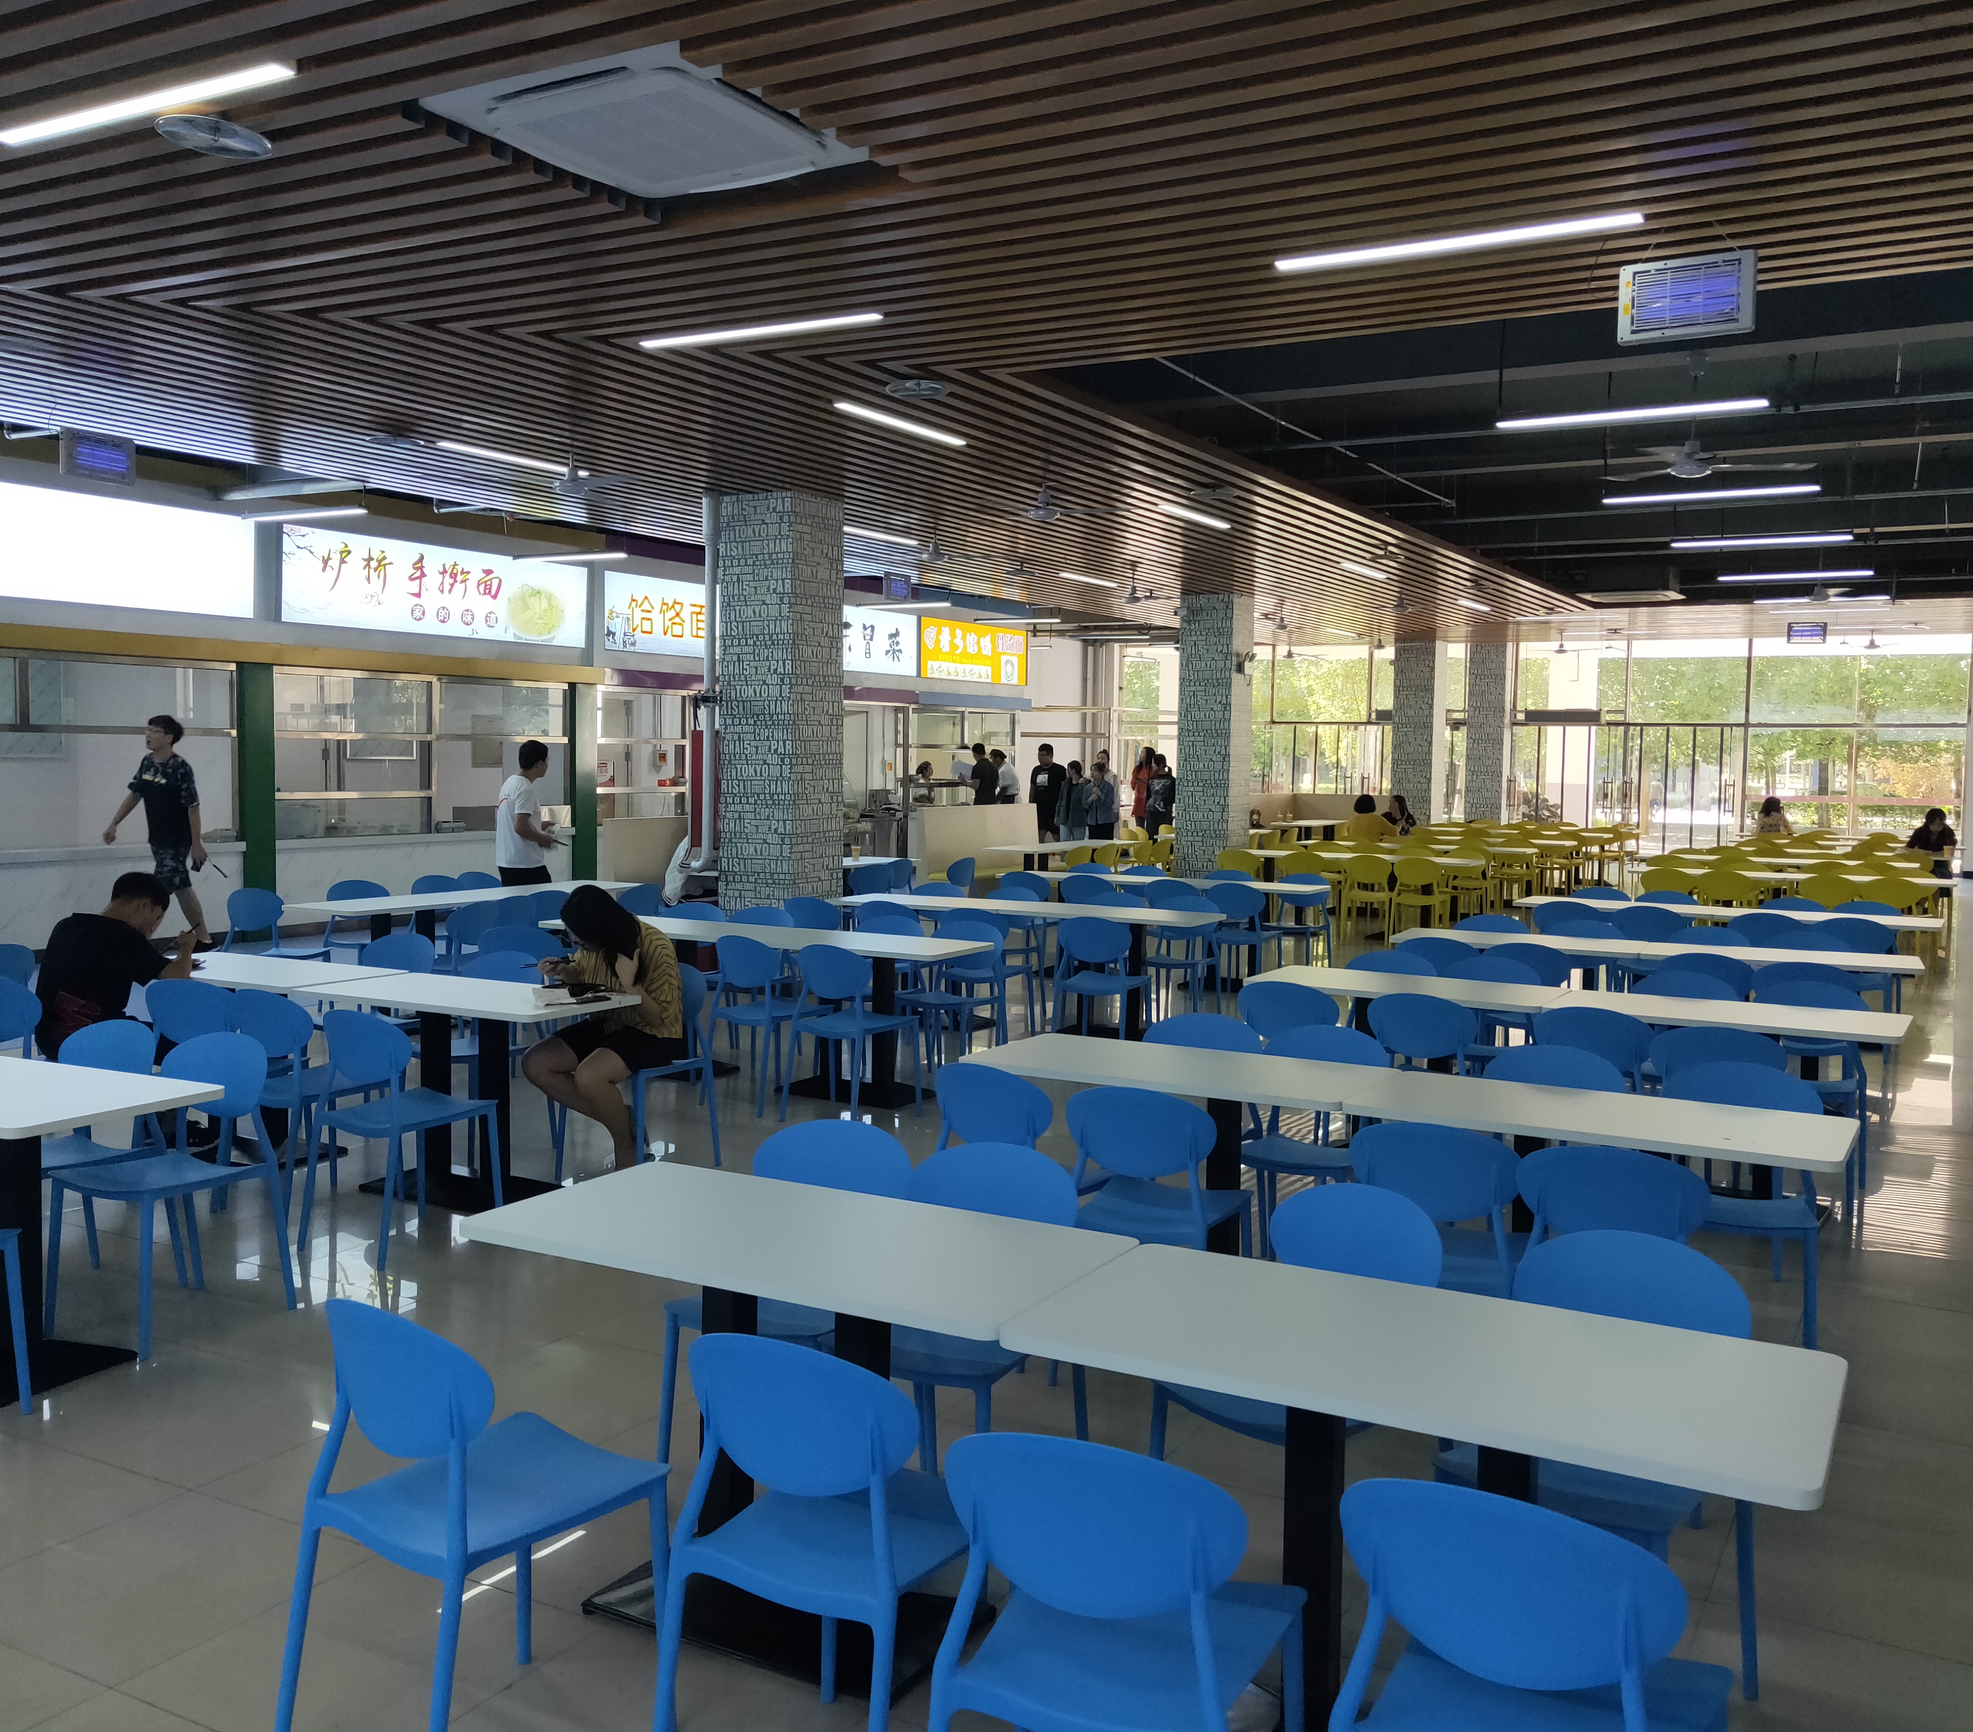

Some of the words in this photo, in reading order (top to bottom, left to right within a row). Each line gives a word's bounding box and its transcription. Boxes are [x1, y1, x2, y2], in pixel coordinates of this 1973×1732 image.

[743, 501, 749, 515] 5
[770, 498, 799, 512] PARIS
[765, 513, 777, 523] 40
[735, 524, 767, 539] TOKYO
[743, 582, 749, 595] 5
[770, 580, 799, 593] PARIS
[766, 593, 777, 604] 40
[411, 604, 498, 628] 家的味道
[628, 594, 705, 639] 饸饹面
[735, 606, 767, 618] TOKYO
[744, 661, 749, 674] 5
[770, 660, 800, 674] PARIS
[766, 674, 777, 684] 40
[736, 685, 768, 697] TOKYO
[744, 741, 750, 753] 5
[771, 741, 800, 754] PARIS
[767, 754, 777, 764] 40
[736, 765, 768, 777] TOKYO
[745, 820, 750, 832] 5
[767, 833, 778, 844] 40
[737, 844, 768, 855] TOKYO
